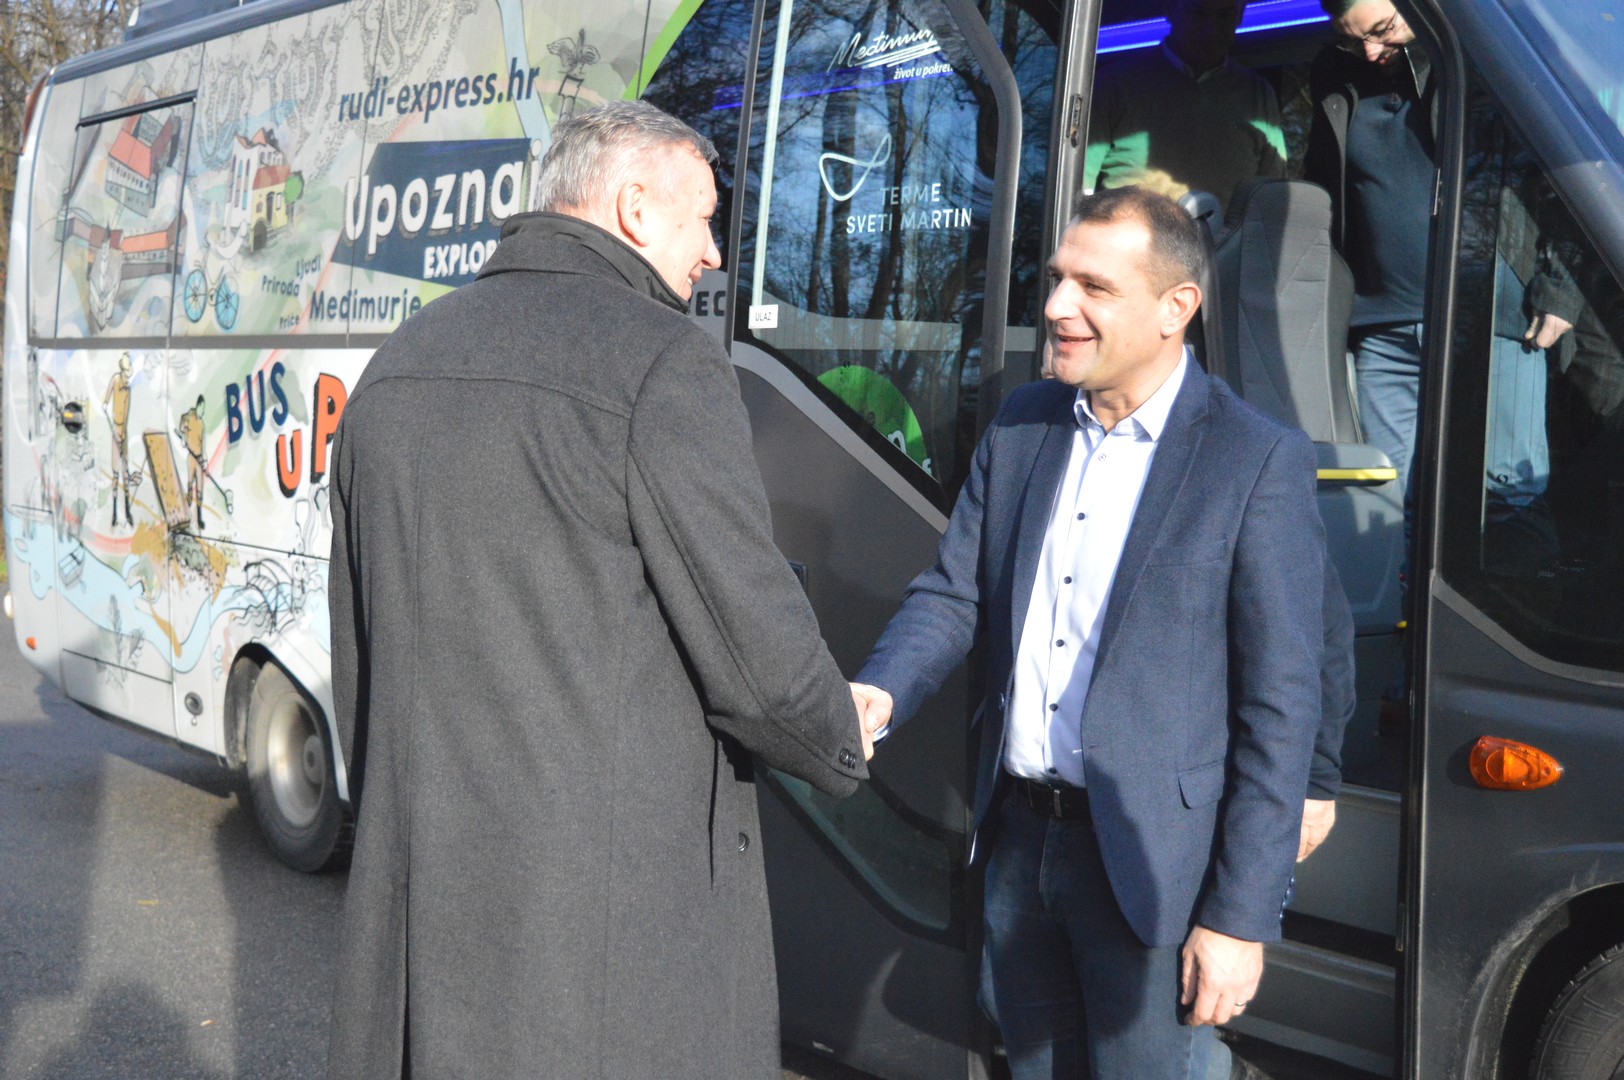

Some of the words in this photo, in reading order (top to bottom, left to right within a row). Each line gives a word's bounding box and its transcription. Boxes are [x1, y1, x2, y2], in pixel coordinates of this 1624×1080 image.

[915, 66, 923, 77] u
[338, 56, 540, 123] rudi-express.hr
[880, 182, 942, 206] TERME
[846, 213, 893, 234] SVETI
[900, 207, 972, 231] MARTIN
[262, 275, 300, 297] Priroda
[279, 314, 299, 330] Price
[226, 361, 289, 445] BUS
